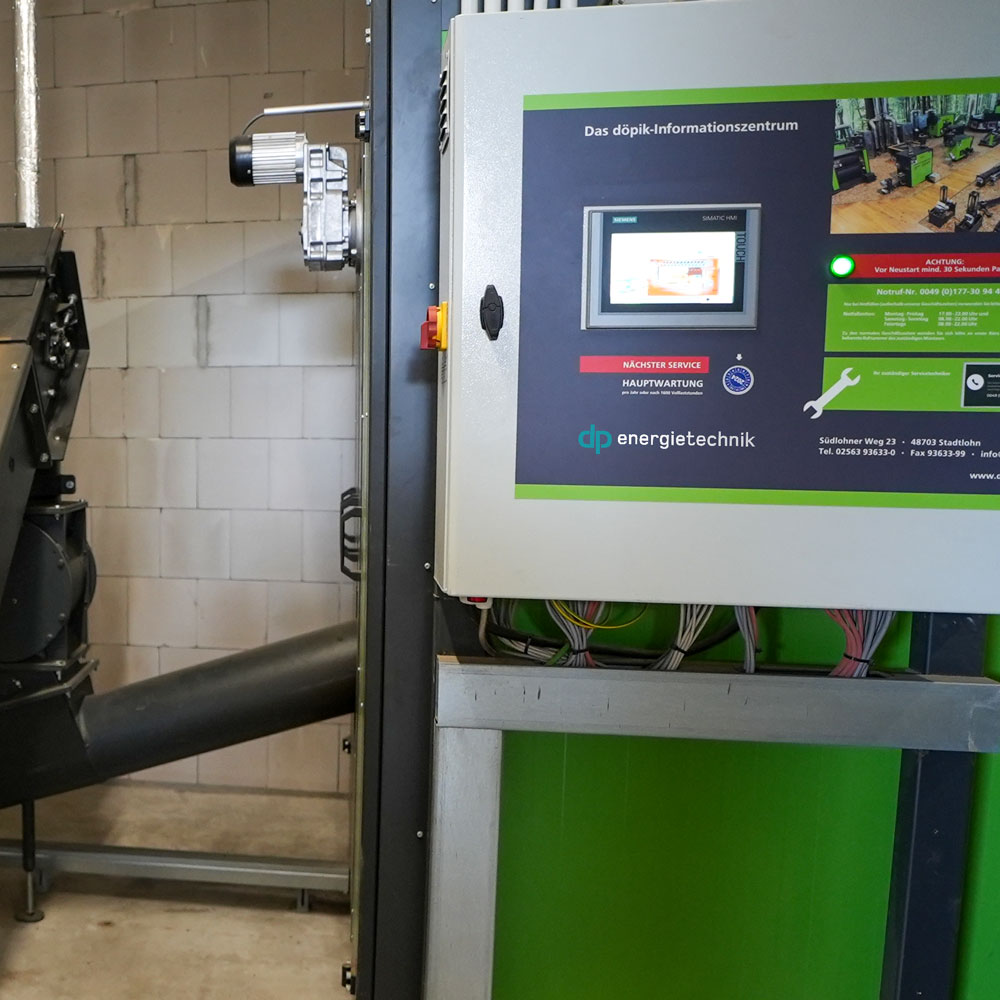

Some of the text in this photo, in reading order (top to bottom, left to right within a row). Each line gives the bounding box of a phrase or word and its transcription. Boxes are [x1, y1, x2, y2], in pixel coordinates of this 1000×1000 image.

[584, 121, 799, 138] Das döpik-Informationszentrum
[736, 232, 746, 263] TOUCH
[925, 258, 965, 266] ACHTUNG:
[954, 265, 990, 273] Sekunden
[622, 359, 702, 369] NÄCHSTER SERVICE
[622, 379, 704, 388] HAUPTWARTUNG
[578, 424, 756, 455] dp energietechnik
[819, 436, 863, 445] Südlohner
[864, 437, 884, 447] Weg
[910, 438, 937, 446] 48703
[938, 438, 982, 447] Stadtlohn
[818, 447, 834, 455] Tel.
[835, 448, 861, 456] 02563
[862, 448, 896, 456] 93633-0
[910, 449, 926, 457] Fax
[927, 449, 966, 458] 93633-99
